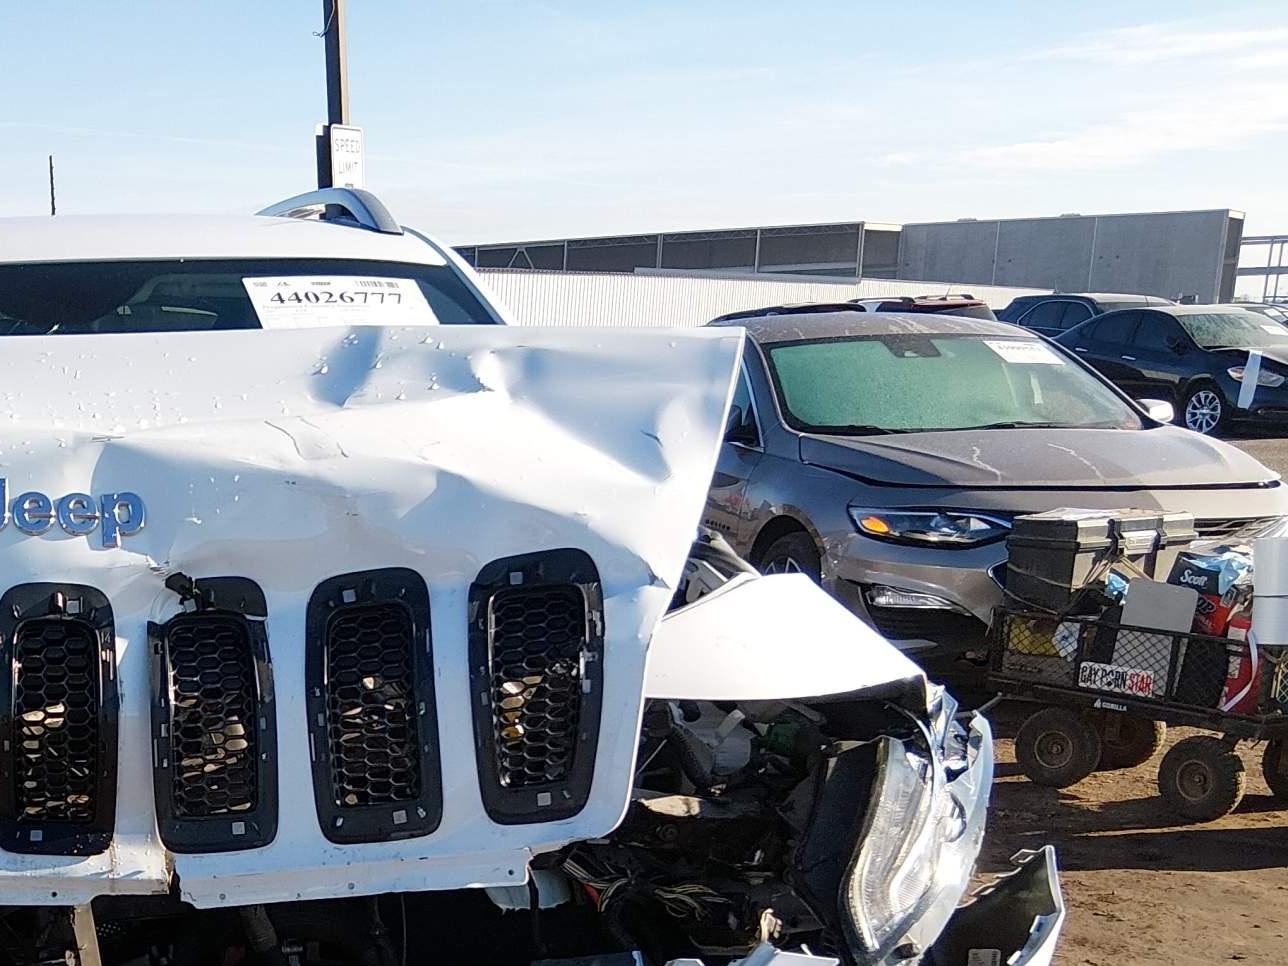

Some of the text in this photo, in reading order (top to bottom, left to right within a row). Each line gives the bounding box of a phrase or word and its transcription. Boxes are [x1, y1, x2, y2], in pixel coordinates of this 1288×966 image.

[335, 138, 361, 153] SPEED
[270, 291, 402, 304] 44026777
[1179, 569, 1208, 586] Scott
[1080, 665, 1099, 684] GAY
[1127, 671, 1153, 695] STAR
